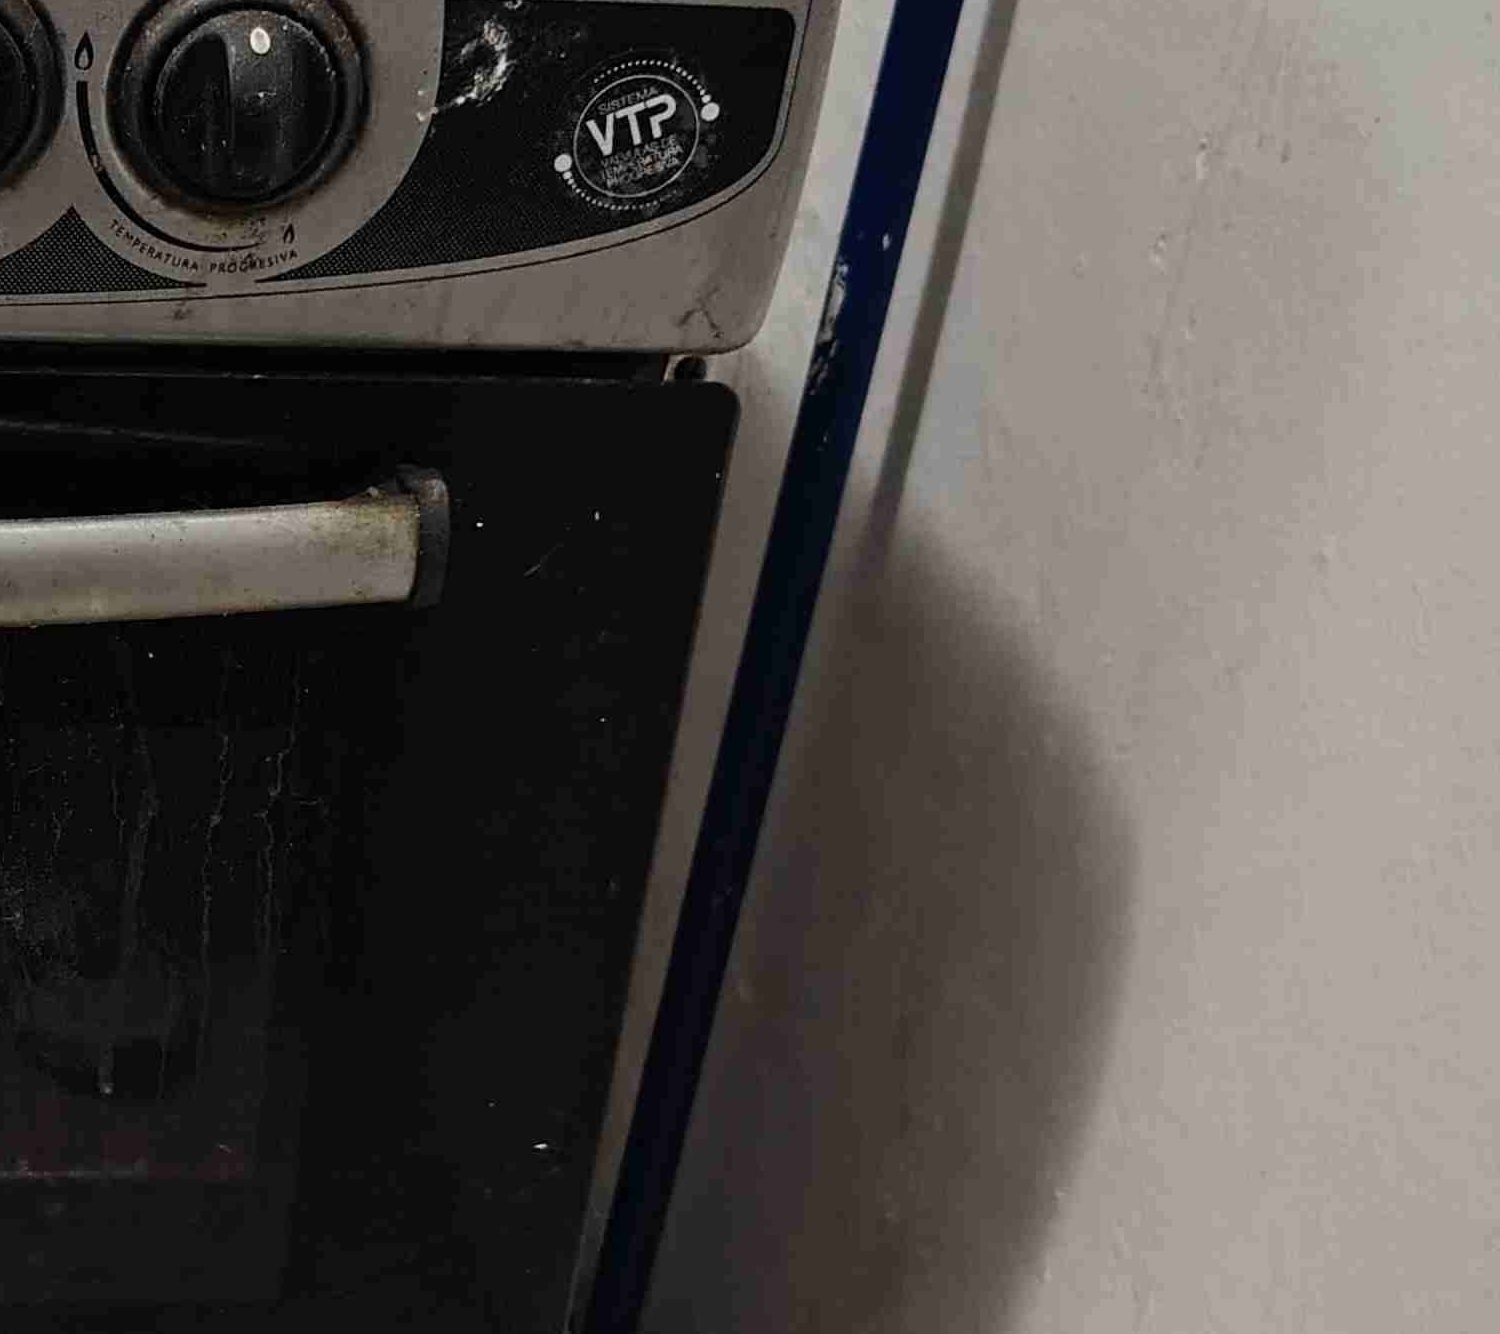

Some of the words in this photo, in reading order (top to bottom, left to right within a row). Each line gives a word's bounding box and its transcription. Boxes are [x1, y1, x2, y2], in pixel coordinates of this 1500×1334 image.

[585, 93, 677, 157] VTP
[109, 218, 199, 271] TEMPERATURA
[209, 250, 298, 274] PROGRESIVA
